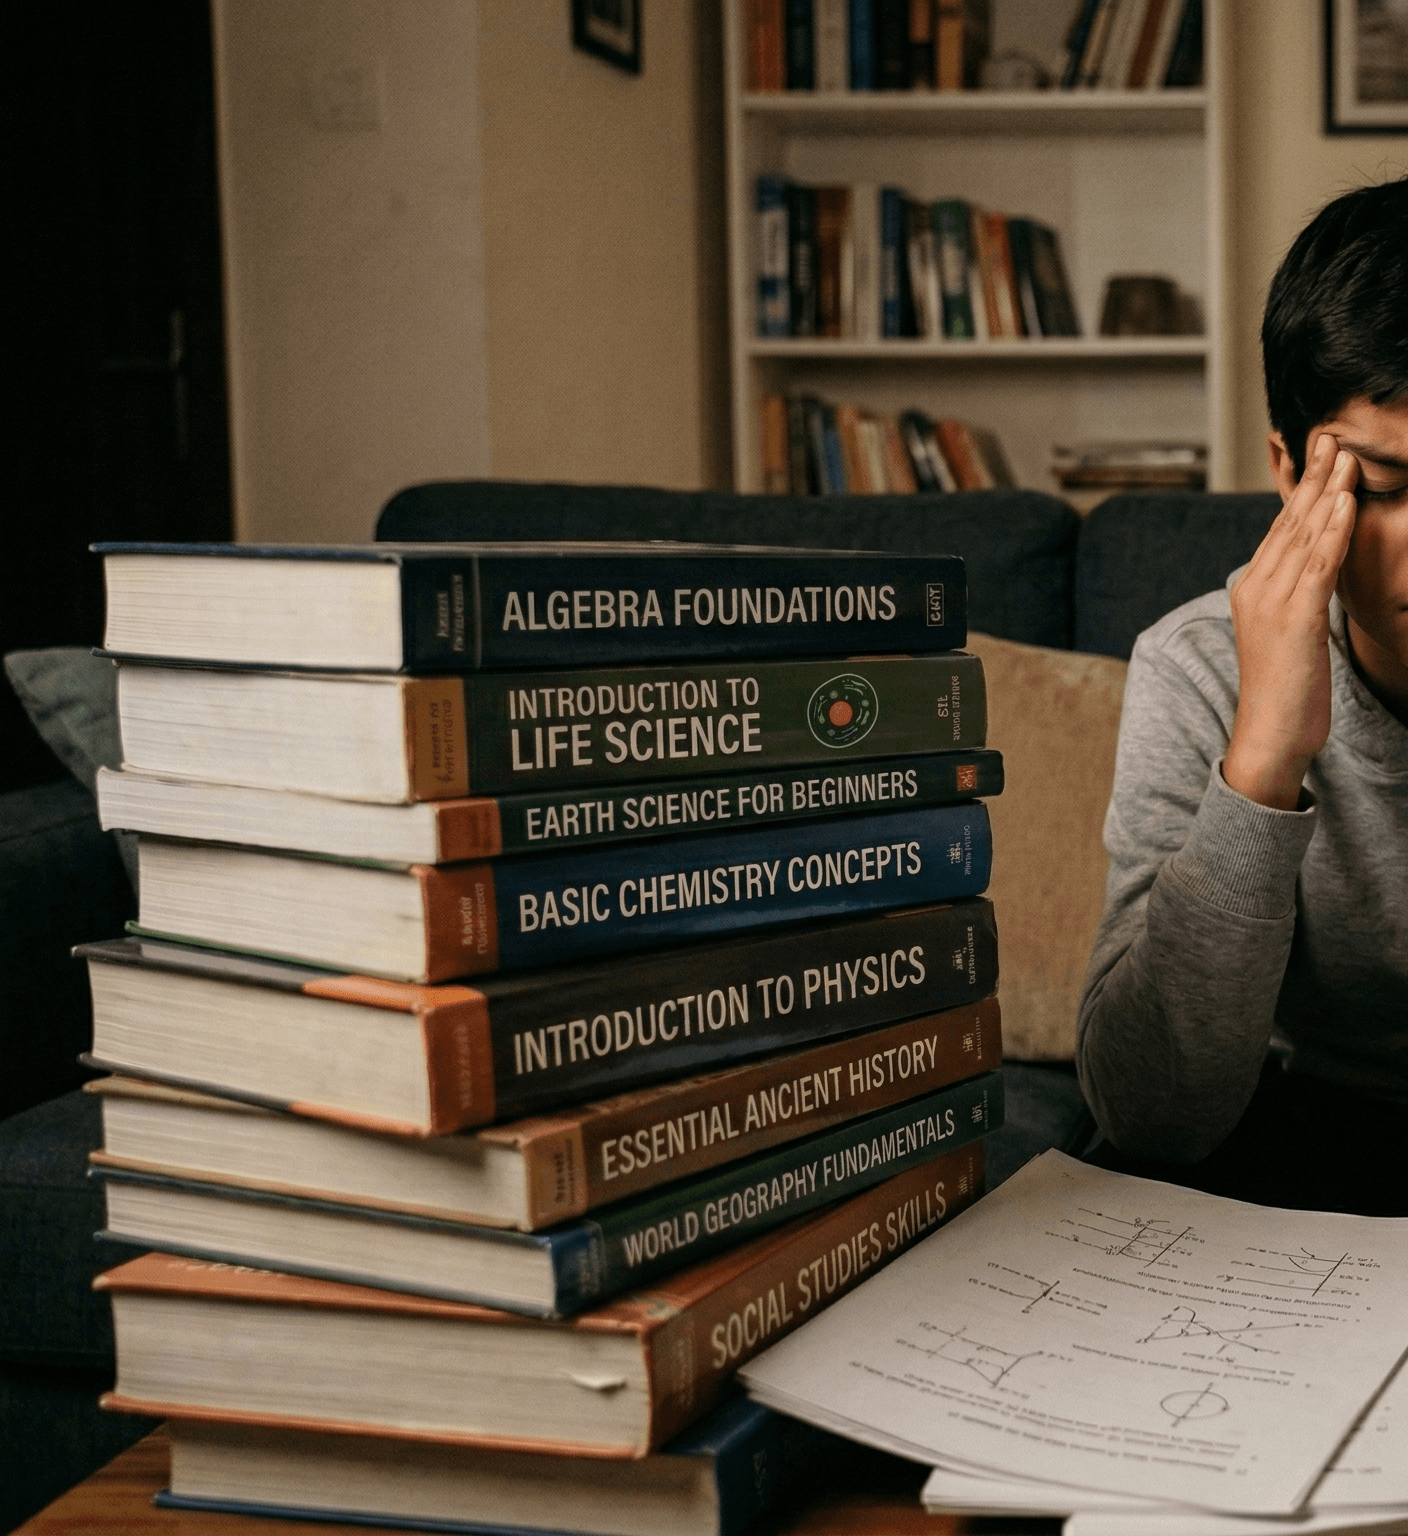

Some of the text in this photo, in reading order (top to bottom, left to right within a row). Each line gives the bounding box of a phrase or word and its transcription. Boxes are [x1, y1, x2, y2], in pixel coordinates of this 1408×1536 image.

[502, 589, 664, 631] ALGEBRA
[674, 585, 896, 626] FOUNDATIONS
[509, 677, 759, 720] INTRODUCTION TO
[511, 723, 593, 771] LIFE
[605, 712, 763, 764] SCIENCE
[526, 800, 615, 841] EARTH
[622, 788, 732, 830] SCIENCE
[737, 783, 784, 816] FOR
[791, 769, 918, 810] BEGINNERS
[519, 883, 611, 933] BASIC
[619, 859, 781, 918] CHEMISTRY
[787, 841, 922, 893] CONCEPTS
[514, 983, 749, 1074] INTRODUCTION
[756, 974, 795, 1019] TO
[803, 945, 926, 1010] PHYSICS
[602, 1102, 740, 1181] ESSENTIAL
[744, 1071, 840, 1132] ANCIENT
[848, 1035, 938, 1097] HISTORY
[622, 1211, 700, 1267] WORLD
[704, 1161, 818, 1234] GEOGRAPHY
[822, 1108, 955, 1187] FUNDAMENTALS
[710, 1181, 948, 1368] SOCIAL STUDIES SKILLS
